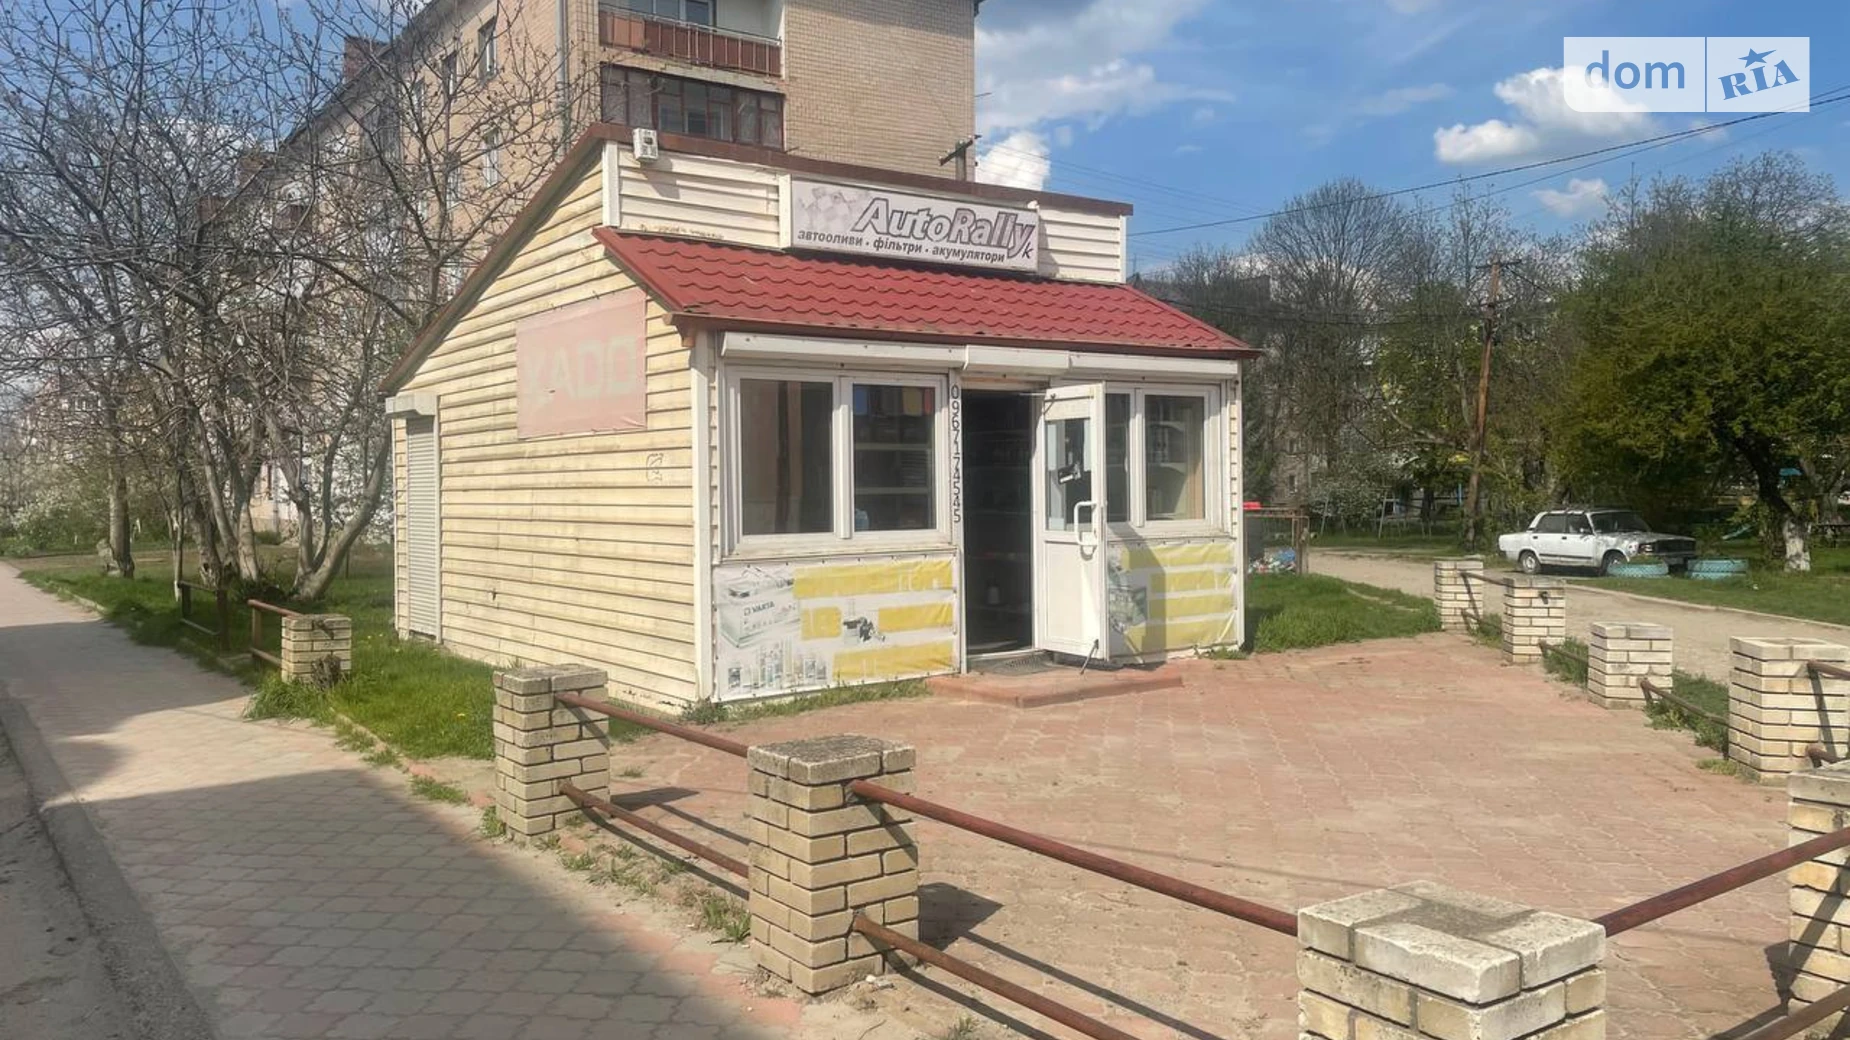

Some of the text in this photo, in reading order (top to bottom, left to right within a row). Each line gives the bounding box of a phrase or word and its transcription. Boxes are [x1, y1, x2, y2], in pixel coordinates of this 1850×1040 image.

[797, 230, 1006, 263] автооливи фільтри акумулятори
[852, 197, 1036, 258] AutoRally
[950, 384, 961, 523] 0967174545
